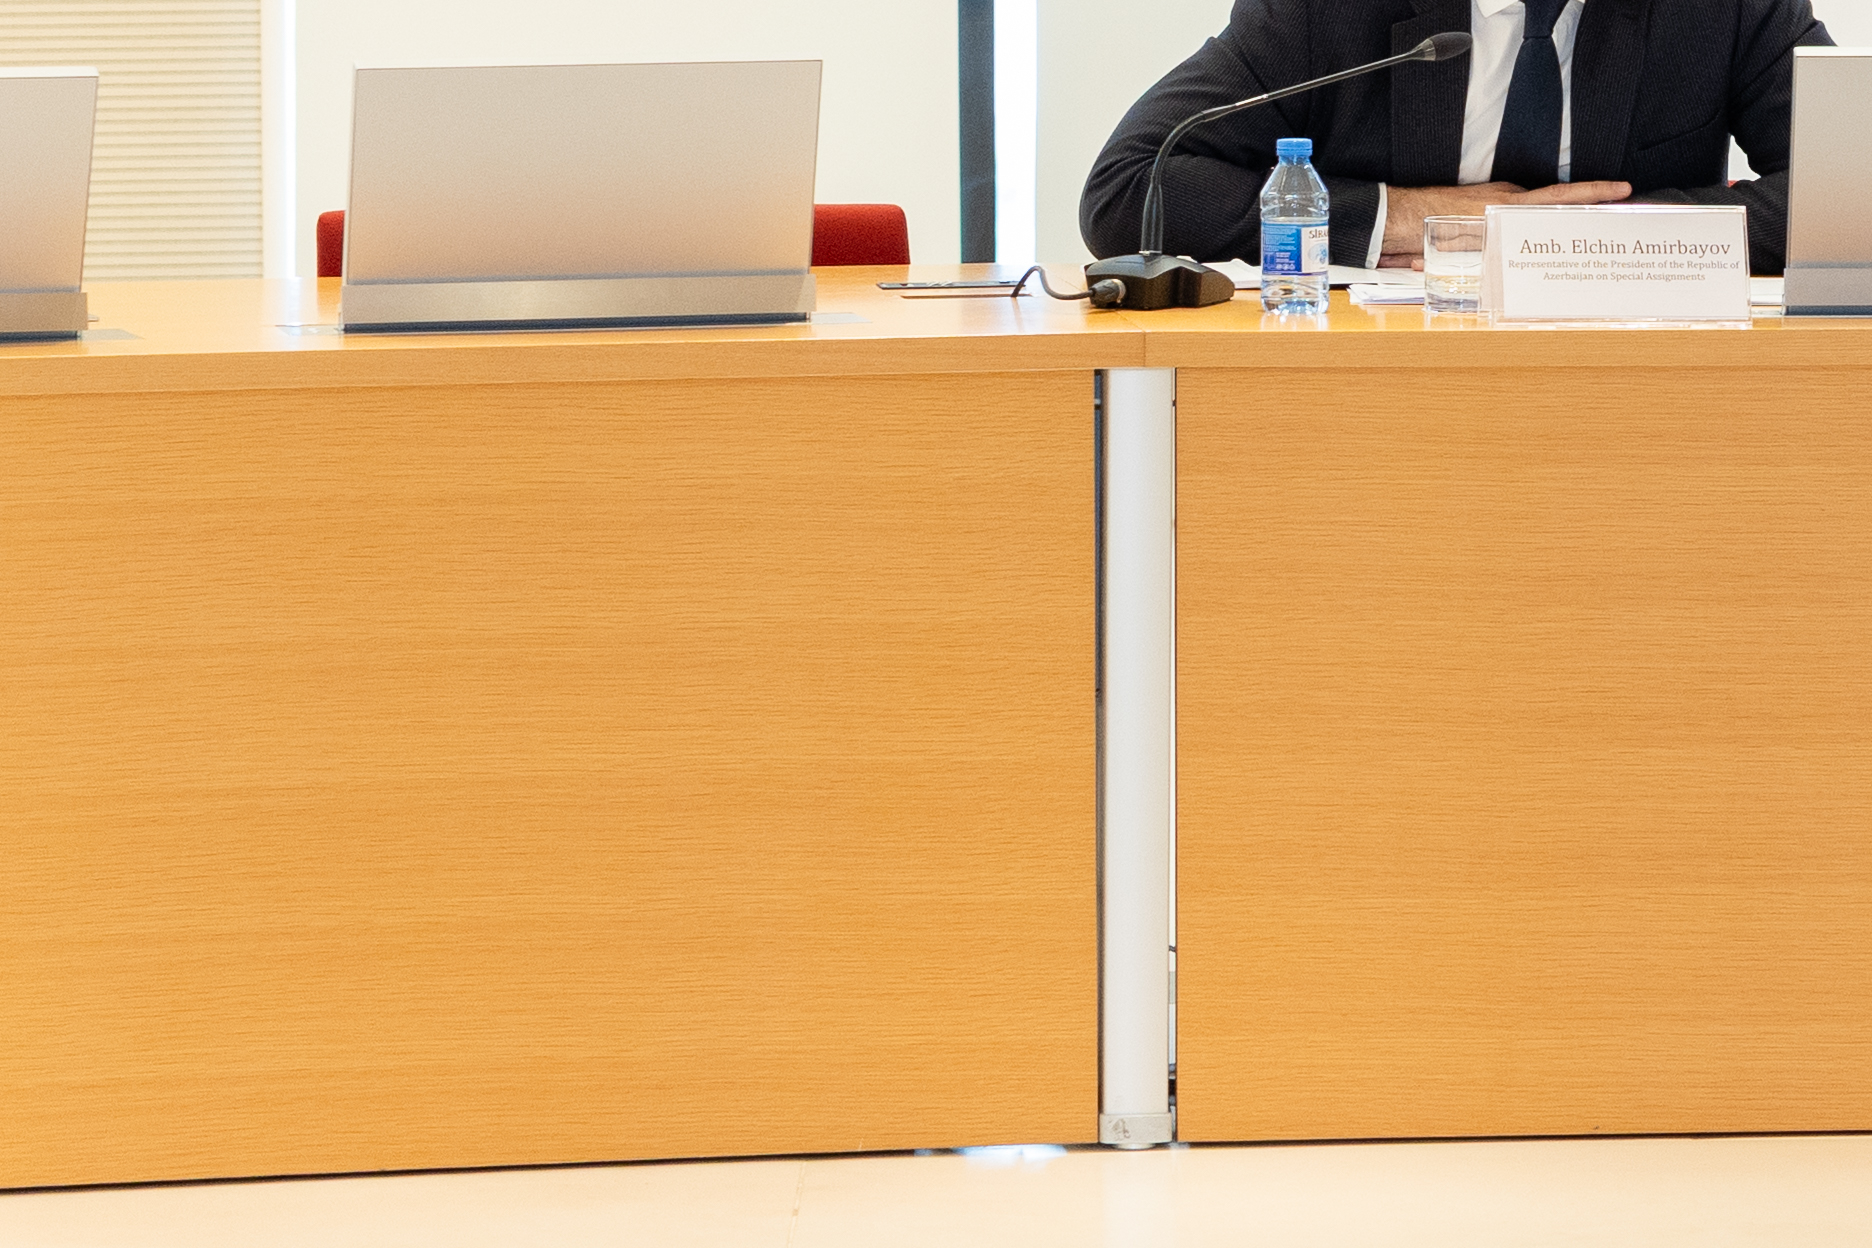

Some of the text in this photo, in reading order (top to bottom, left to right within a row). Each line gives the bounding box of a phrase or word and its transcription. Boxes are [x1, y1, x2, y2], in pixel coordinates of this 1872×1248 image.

[1520, 239, 1731, 259] Amb. Elchin Amirbayov
[1508, 259, 1740, 271] Representative of the President of the Republic of
[1543, 271, 1706, 282] Azerbaijan on Special Assignments
